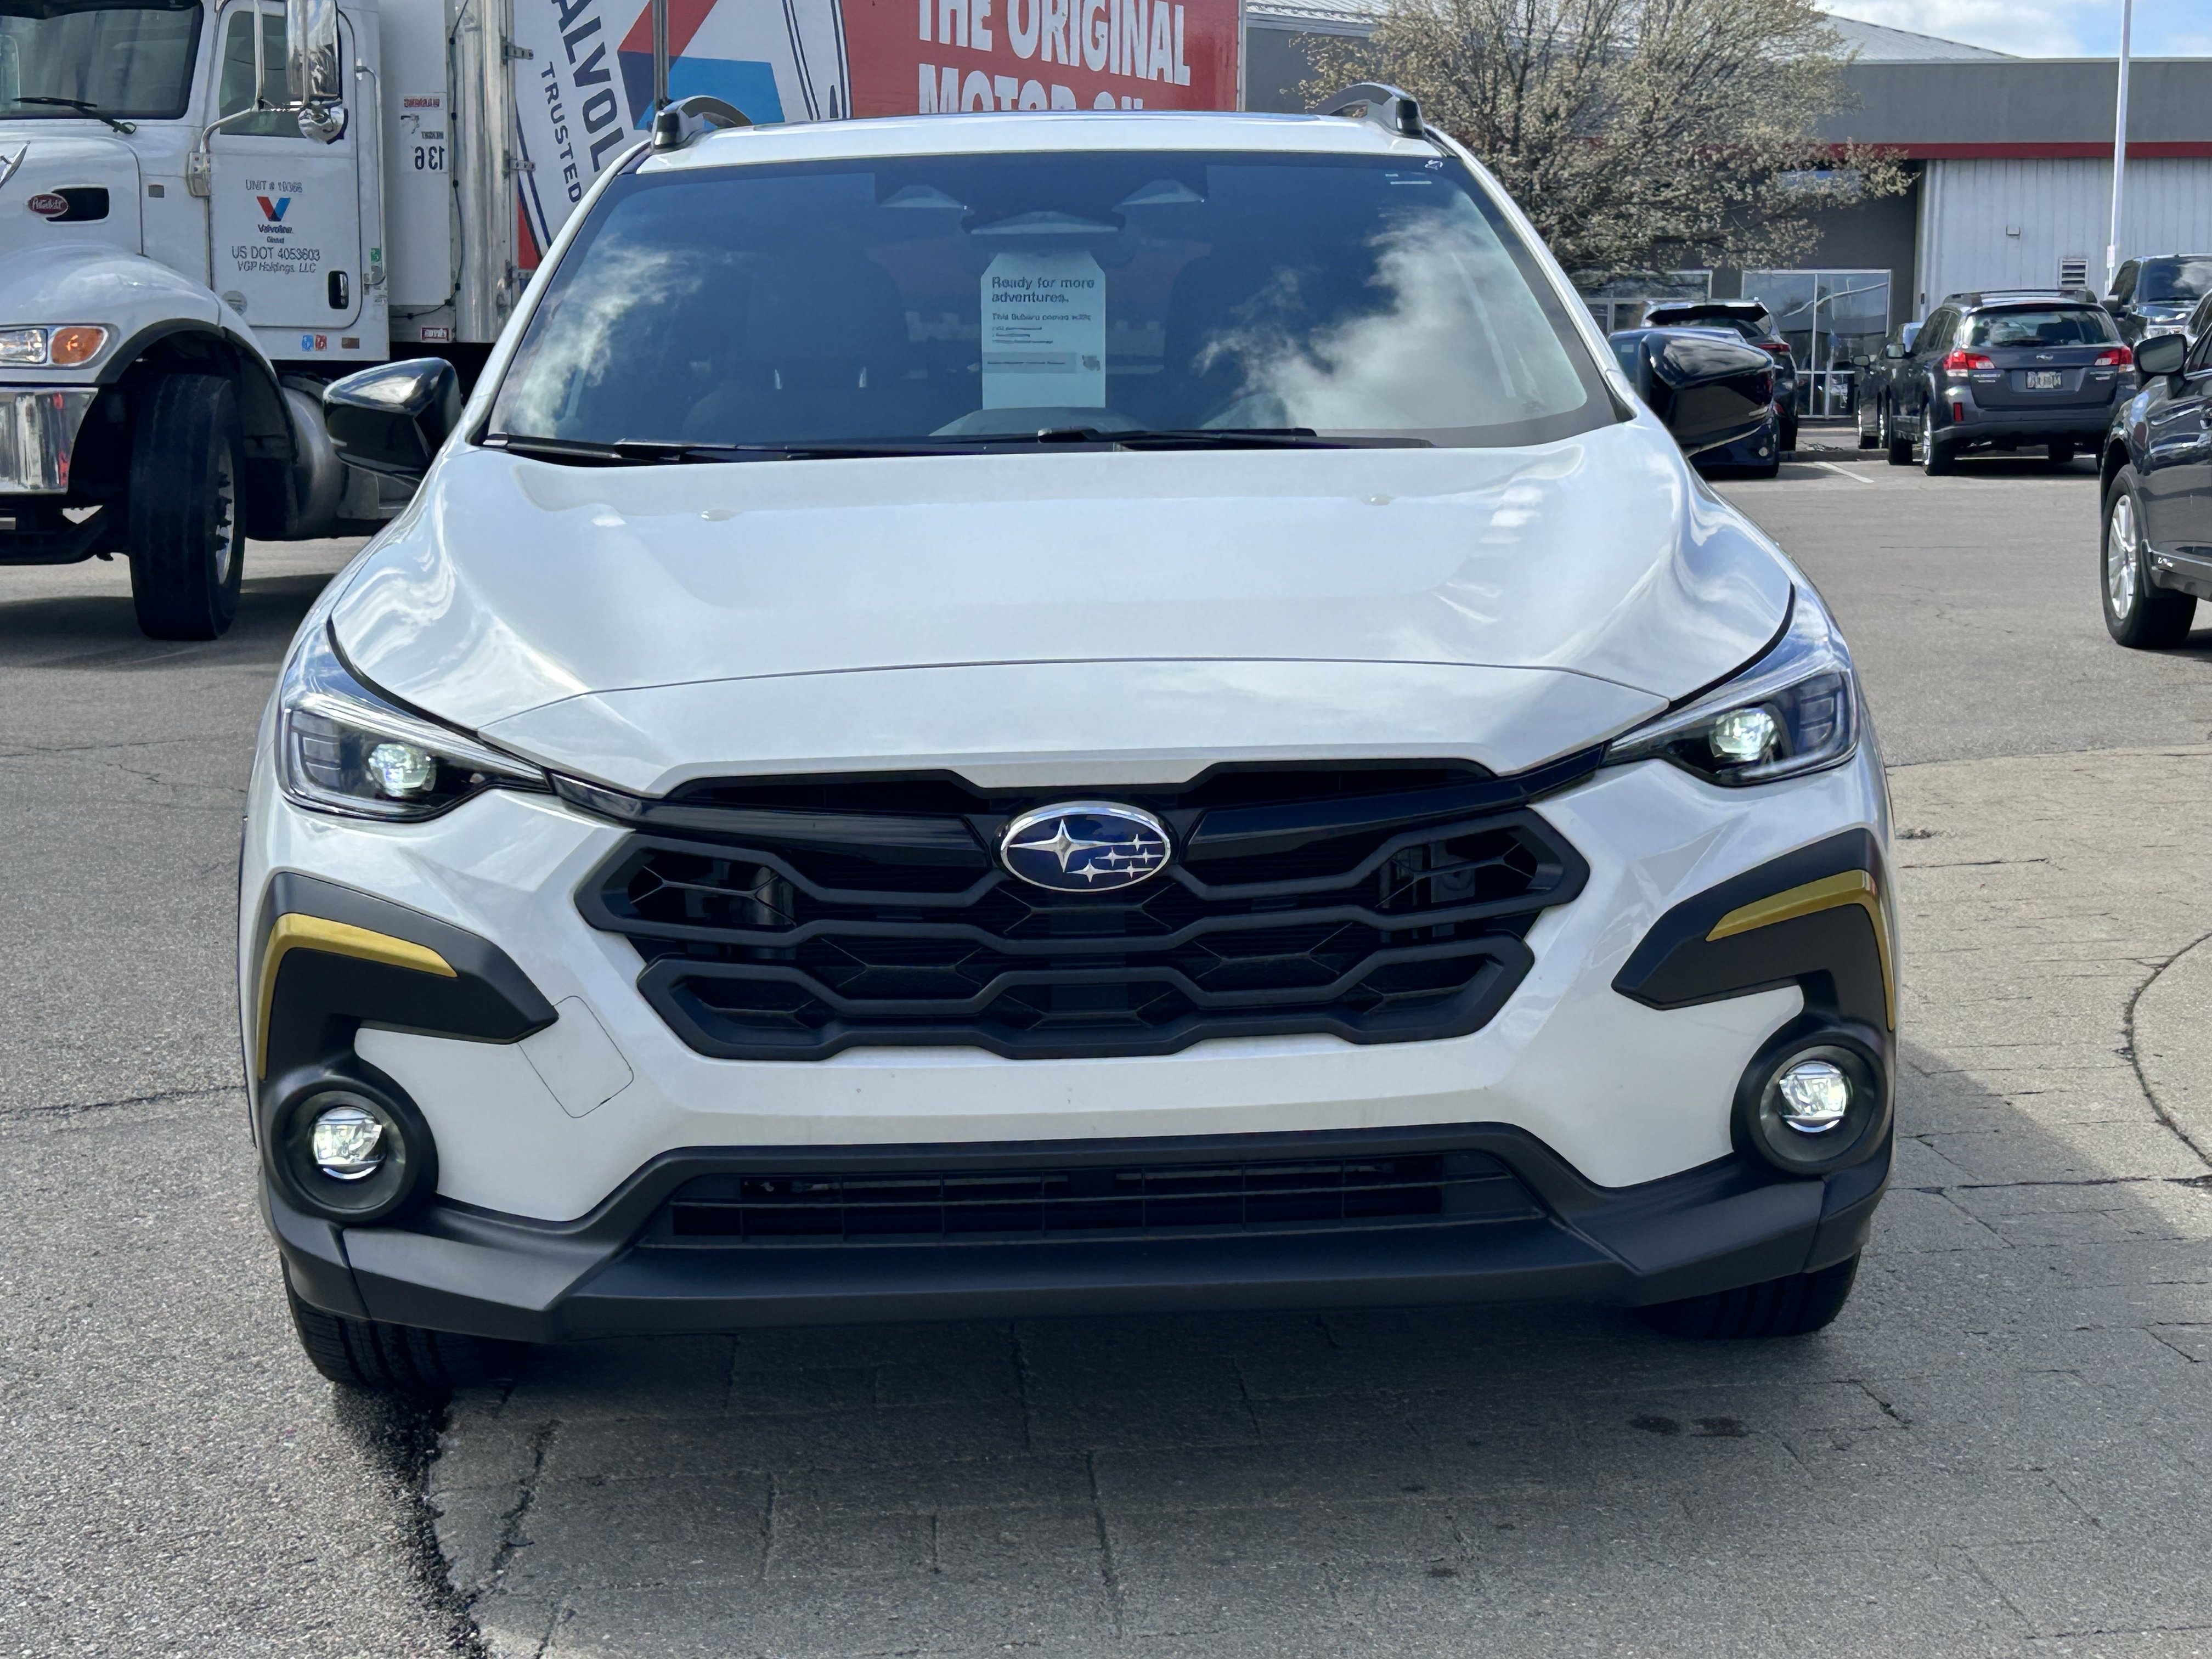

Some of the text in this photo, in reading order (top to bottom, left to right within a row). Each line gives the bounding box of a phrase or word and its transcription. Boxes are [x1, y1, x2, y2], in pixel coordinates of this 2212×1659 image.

[1007, 0, 1190, 86] ORIGINAL
[541, 61, 582, 203] TRUSTED
[246, 179, 266, 190] UNIT
[232, 246, 247, 259] US
[251, 246, 274, 259] DOT
[300, 263, 316, 273] LLC
[992, 276, 1094, 290] Ready for more
